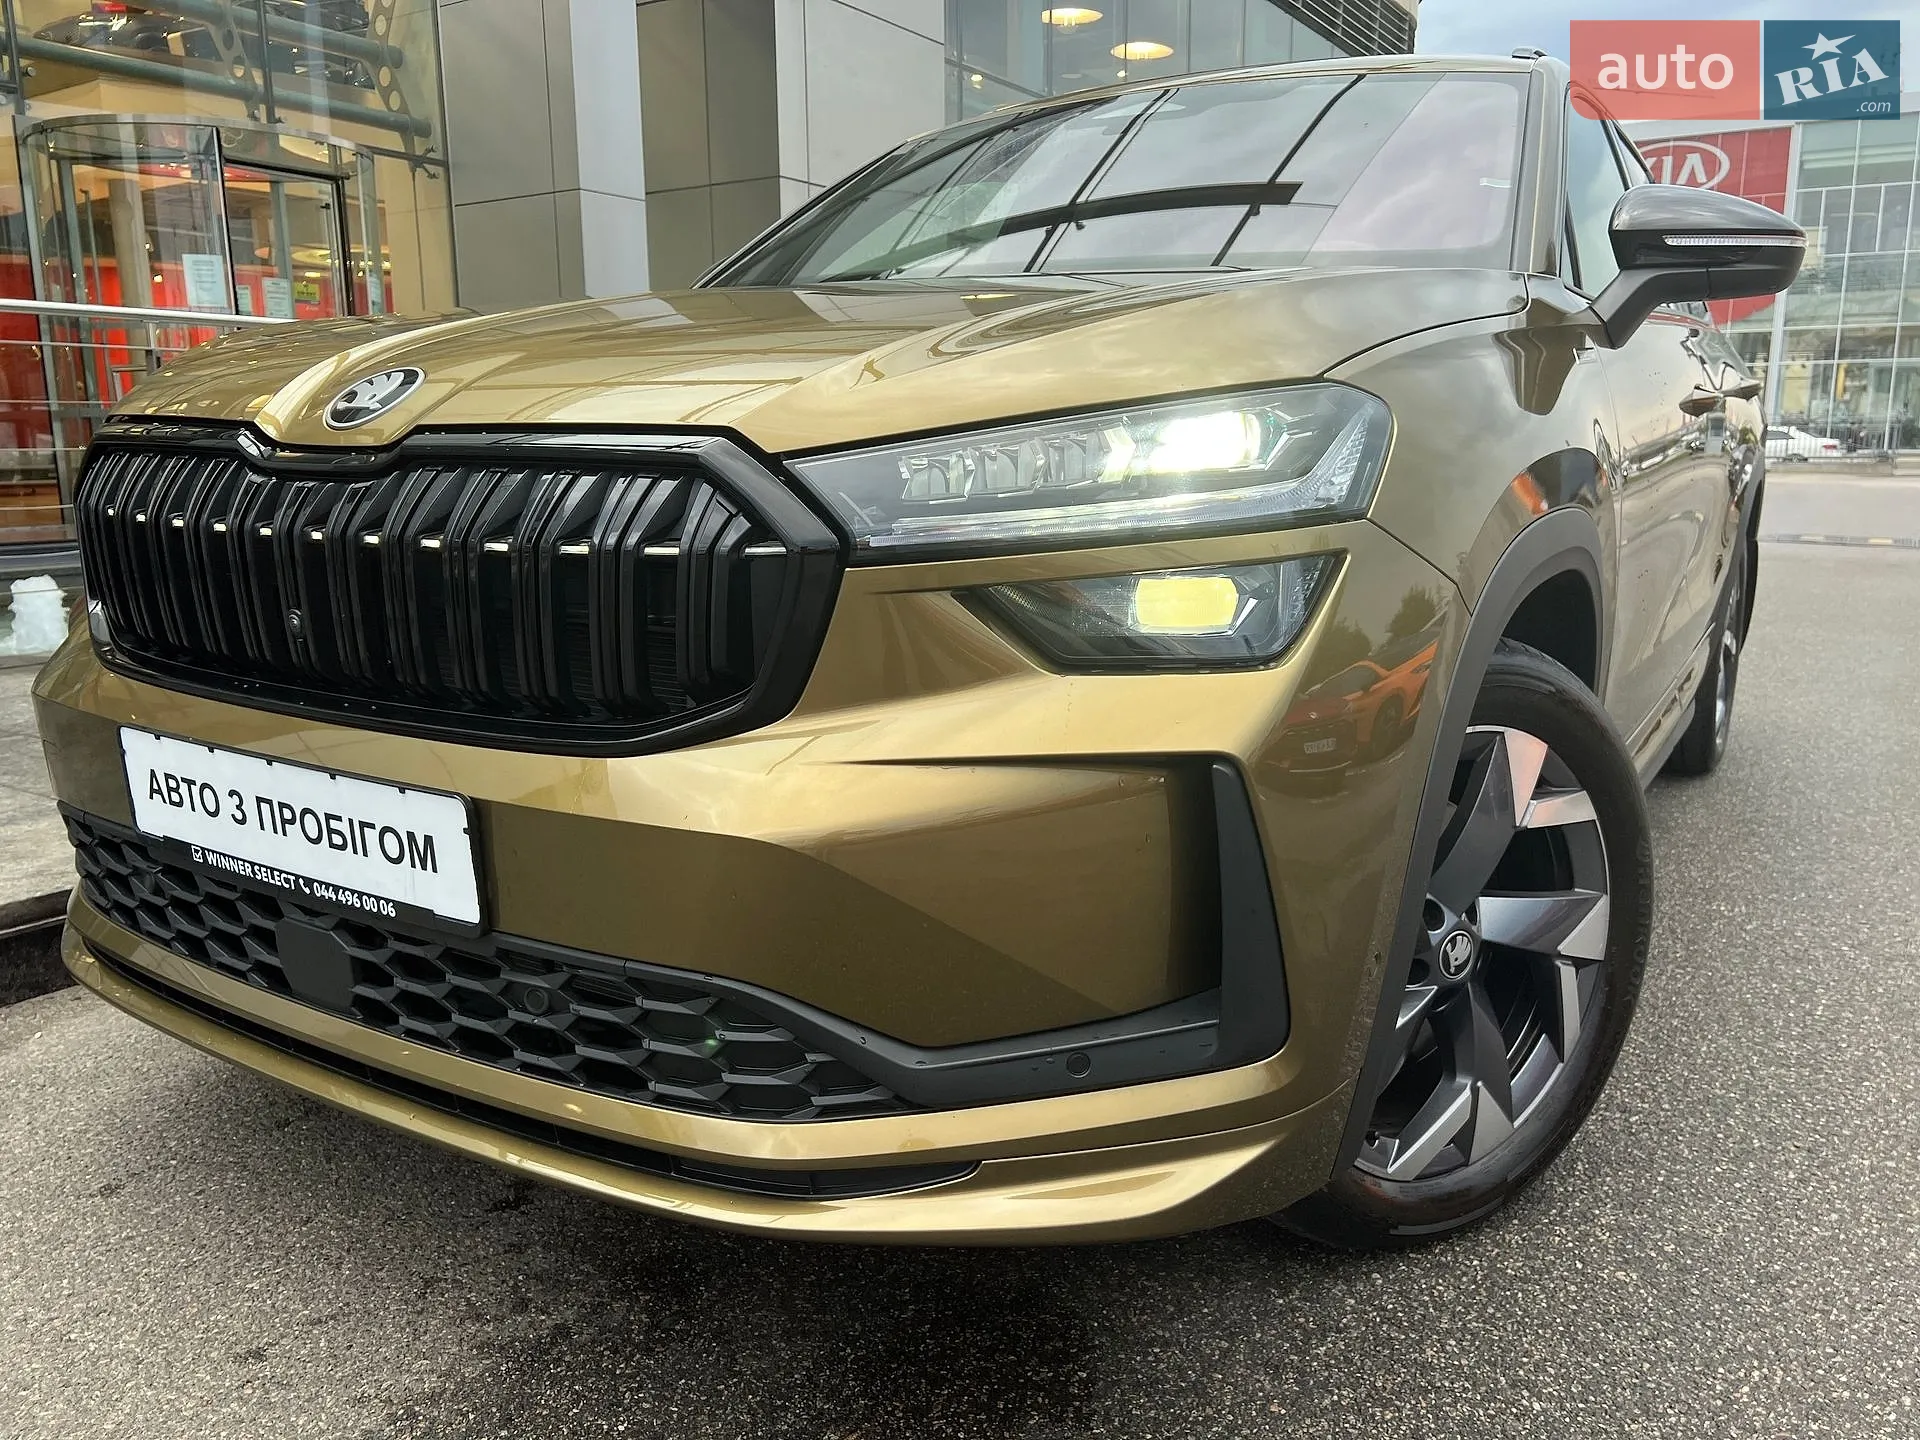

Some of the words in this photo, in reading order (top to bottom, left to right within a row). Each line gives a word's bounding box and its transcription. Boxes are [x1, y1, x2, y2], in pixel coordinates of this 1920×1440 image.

[149, 768, 220, 818] АВТО
[255, 796, 438, 873] ПРОБІГОМ
[205, 850, 253, 878] WINNER
[254, 865, 296, 890] SELECT
[313, 882, 336, 901] 044
[338, 889, 360, 908] 496
[362, 895, 378, 913] 00
[380, 900, 396, 917] 06
